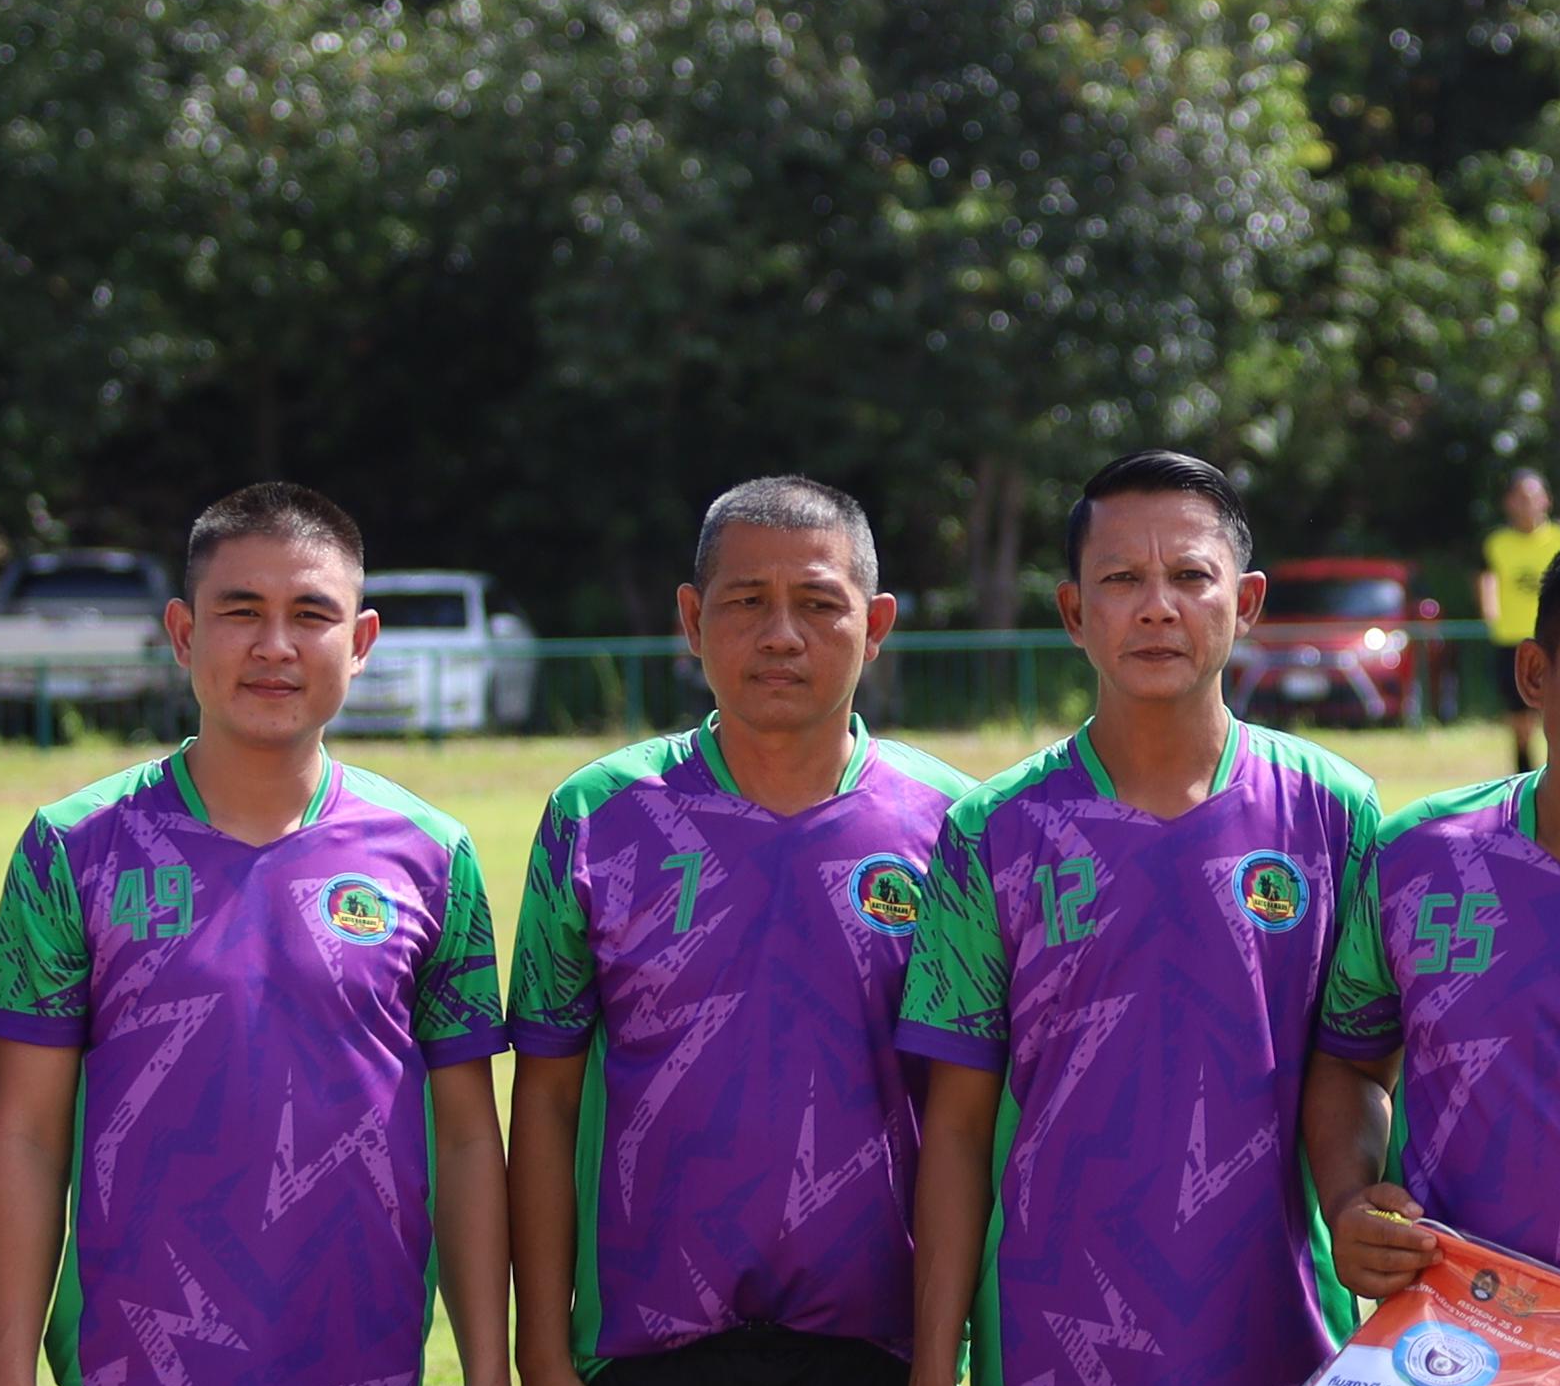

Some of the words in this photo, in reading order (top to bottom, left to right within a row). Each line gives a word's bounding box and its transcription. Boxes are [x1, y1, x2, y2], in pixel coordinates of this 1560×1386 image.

[110, 864, 193, 942] 49
[660, 852, 704, 934] 7
[1033, 857, 1097, 947] 12
[1414, 893, 1499, 975] 55
[1496, 1318, 1513, 1331] 25
